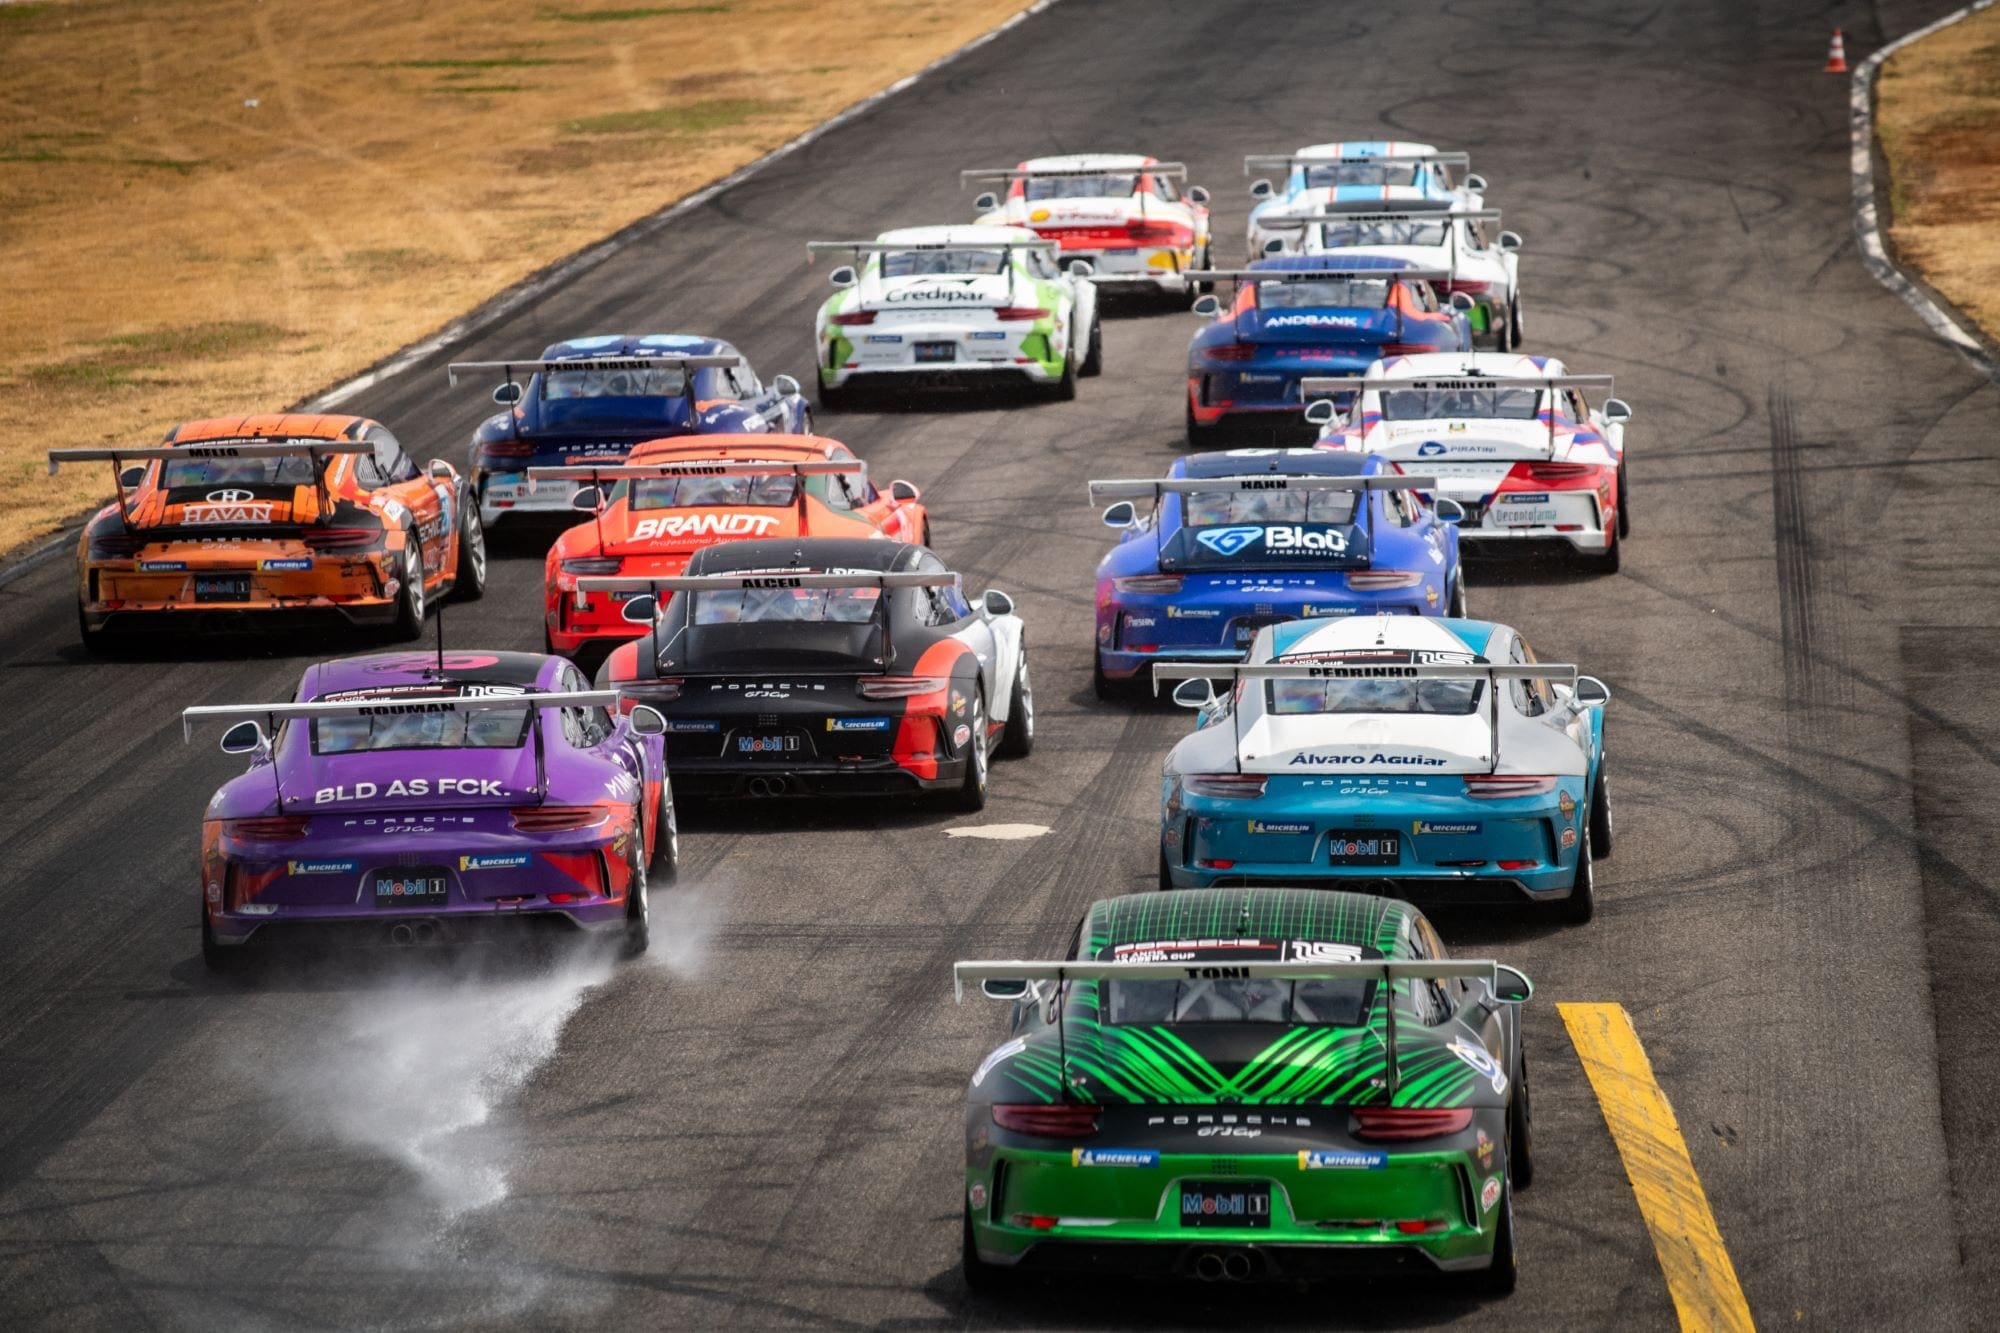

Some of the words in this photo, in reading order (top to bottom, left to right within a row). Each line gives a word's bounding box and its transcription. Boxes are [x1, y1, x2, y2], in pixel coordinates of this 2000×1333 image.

[886, 286, 985, 302] Credipar
[1265, 315, 1357, 327] ANDBANK
[559, 443, 633, 451] PORSCH
[660, 467, 726, 475] PALUDO
[1241, 481, 1287, 489] HAHN
[184, 507, 270, 524] HAVAN
[1496, 506, 1557, 523] Decontofarma
[627, 514, 780, 542] BRANDT
[742, 578, 801, 588] ALCEU
[1308, 667, 1418, 678] PEDRINHO
[711, 683, 825, 691] PORSCHE
[358, 703, 455, 715] ROUMAN
[738, 736, 783, 751] Mobil
[1288, 752, 1365, 766] Álvaro
[1369, 753, 1448, 767] Aguiar
[315, 782, 377, 804] BLD
[386, 780, 429, 797] AS
[438, 778, 511, 796] FCK.
[345, 816, 475, 826] PORSCHE
[1265, 823, 1310, 832] MICHELIN
[1432, 824, 1477, 832] MICHELIN
[1330, 839, 1378, 855] Mobil
[307, 862, 353, 872] MICHELIN
[479, 856, 527, 867] MICHELIN
[376, 880, 427, 896] Mobil
[1114, 939, 1261, 954] PORSCHE
[1185, 967, 1250, 979] TONI
[1149, 1115, 1311, 1126] PORSCHE
[1095, 1154, 1151, 1164] MICHELIN
[1323, 1155, 1381, 1166] MICHELIN
[1182, 1194, 1245, 1215] Mobil
